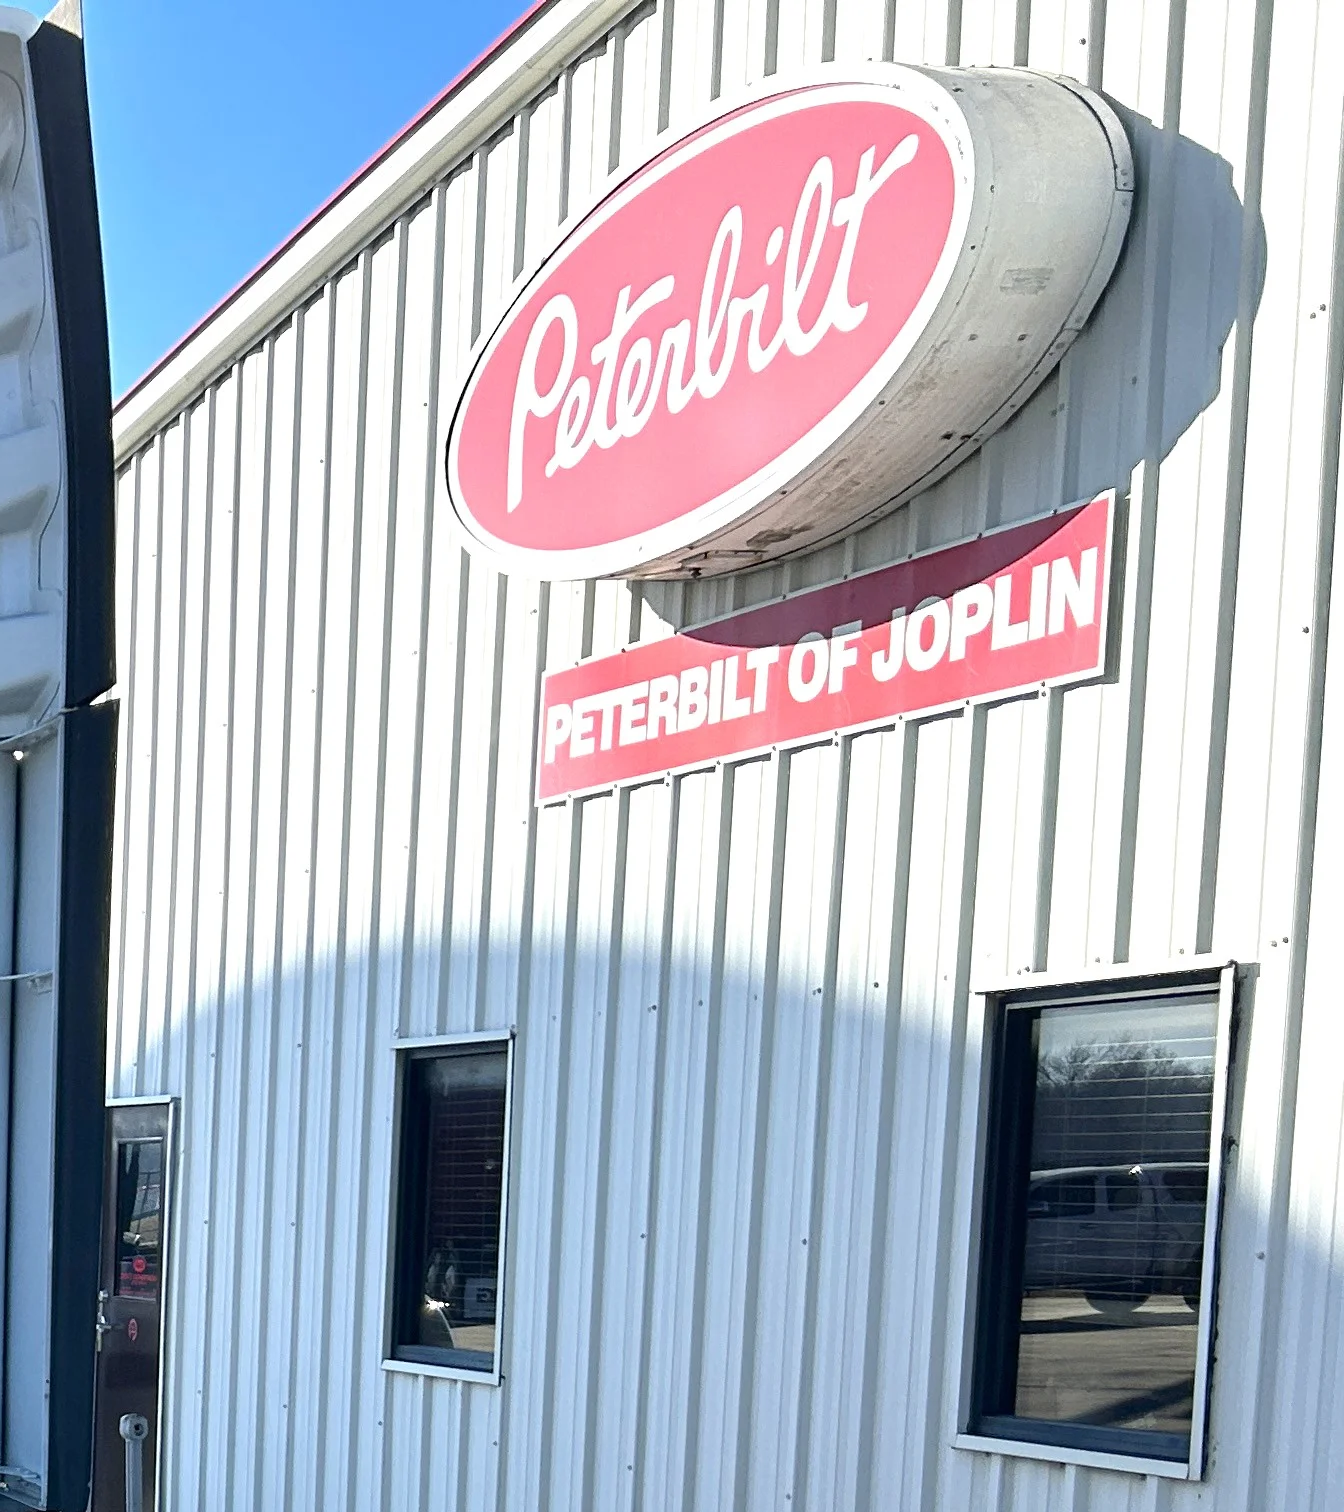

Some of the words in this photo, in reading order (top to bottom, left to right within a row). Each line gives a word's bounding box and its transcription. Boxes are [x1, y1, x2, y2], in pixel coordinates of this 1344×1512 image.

[507, 132, 920, 514] Peterbilt
[544, 643, 780, 766] PETERBILT
[787, 622, 865, 704] OF
[870, 546, 1100, 684] JOPLIN
